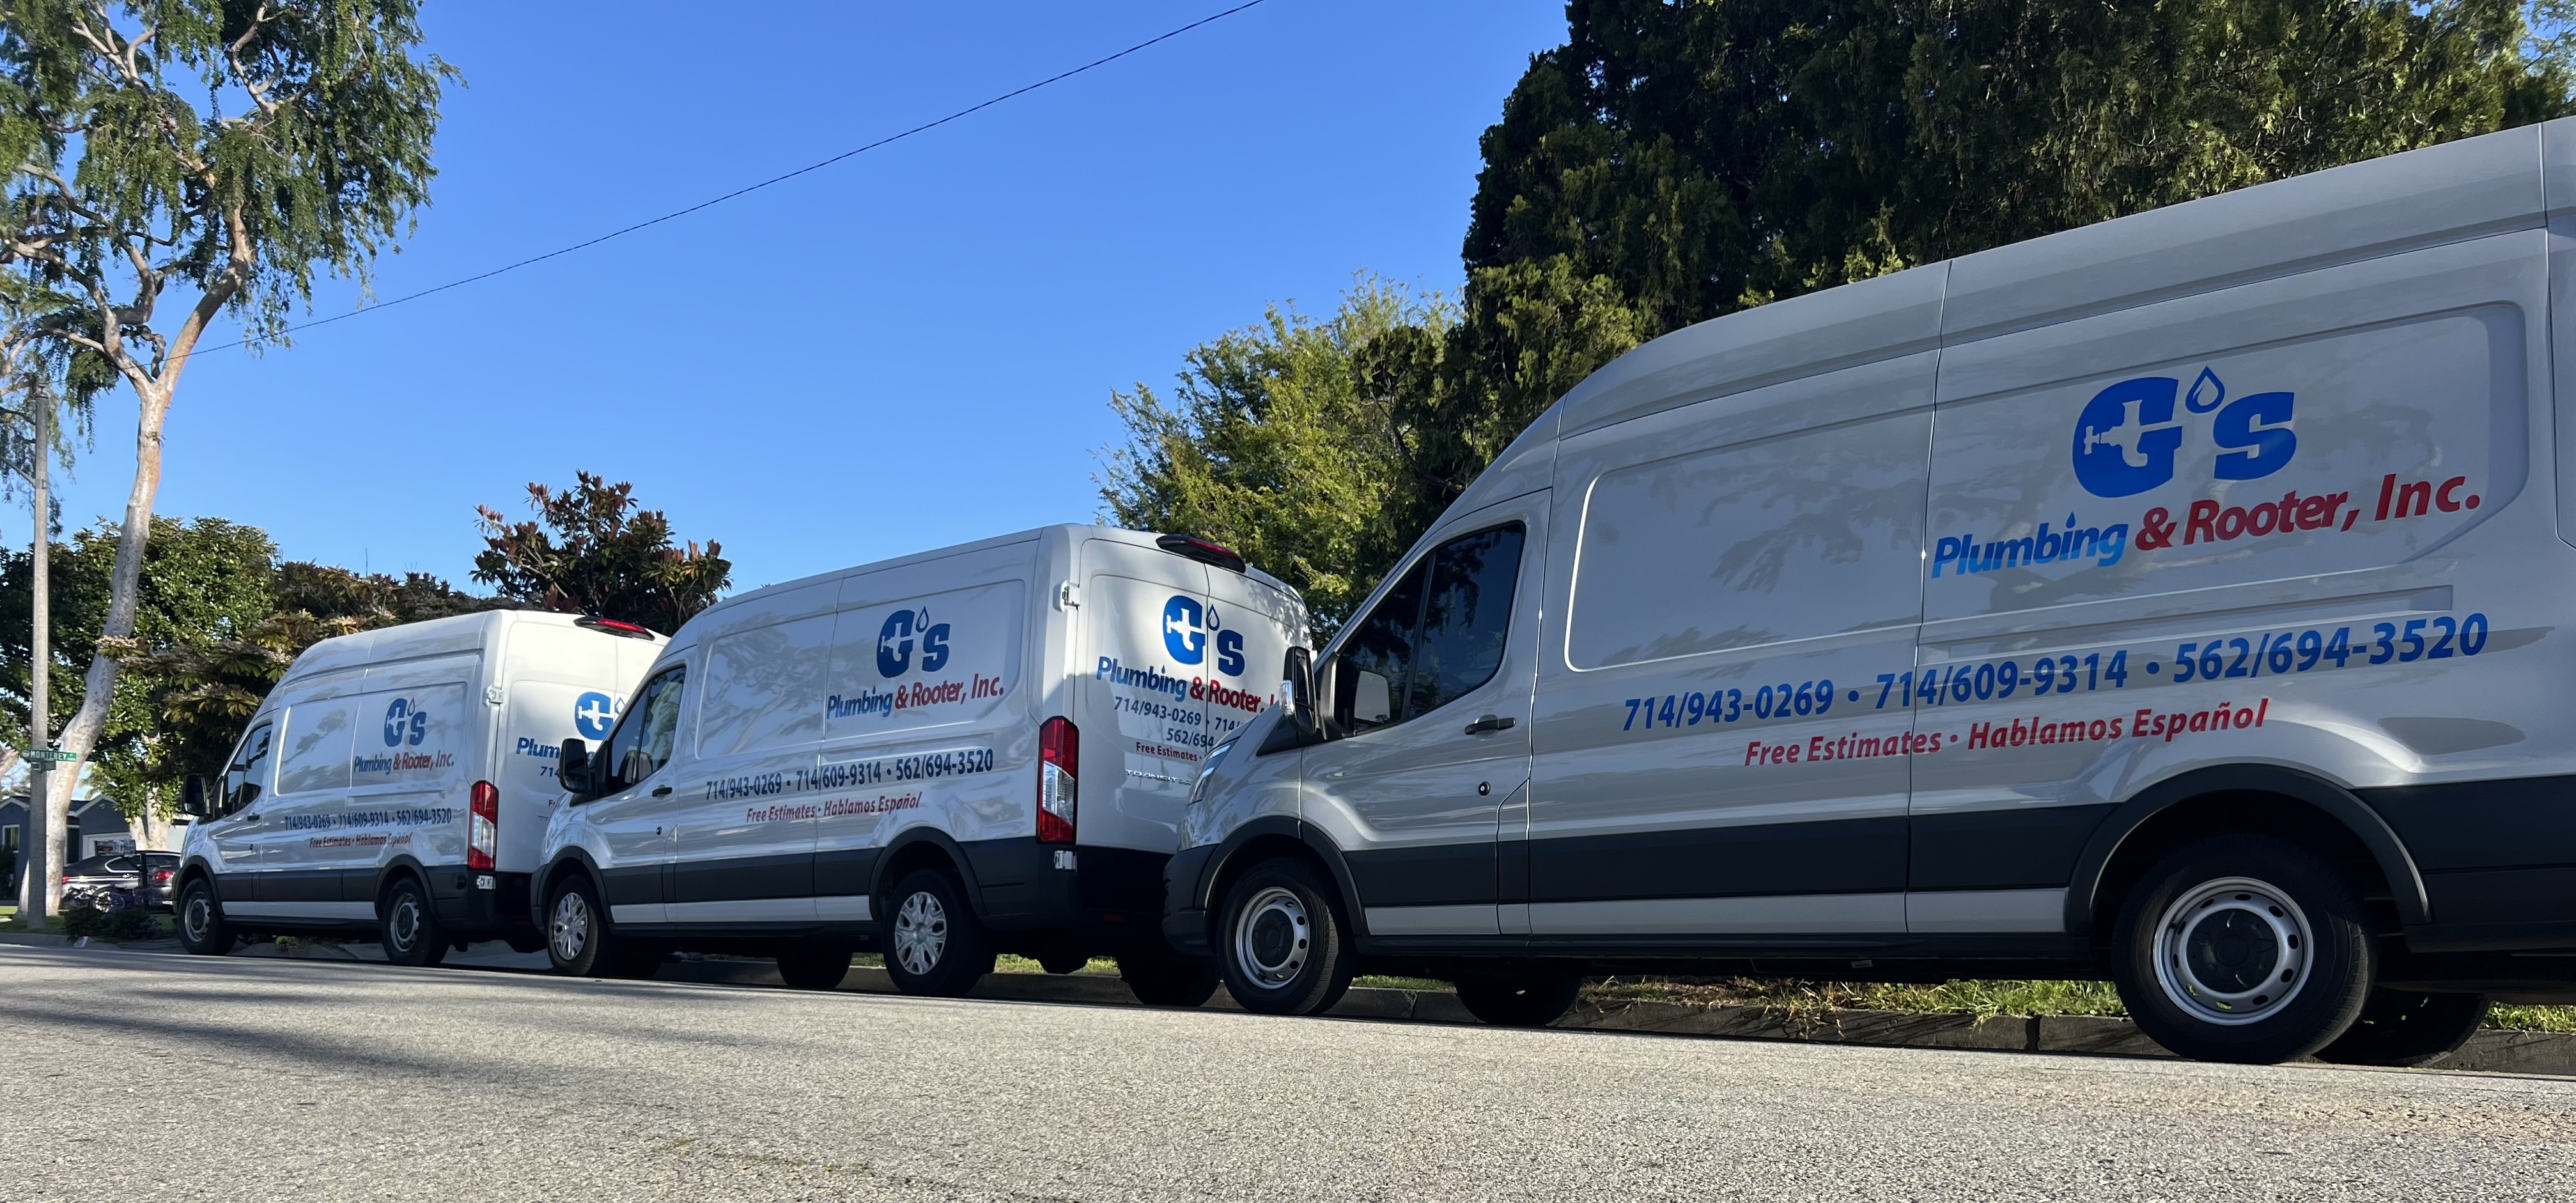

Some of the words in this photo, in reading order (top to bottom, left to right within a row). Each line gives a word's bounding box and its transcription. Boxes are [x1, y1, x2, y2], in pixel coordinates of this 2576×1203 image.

[1931, 511, 2129, 579] Plumbing
[2135, 507, 2178, 551] &
[2183, 490, 2361, 545] Rooter,
[2375, 473, 2481, 521] Inc.
[1096, 656, 1187, 702] Plumbing
[1190, 676, 1206, 701] &
[1623, 679, 1834, 731] 714/943-0269
[1875, 650, 2128, 709] 714/609-9314
[2173, 613, 2488, 682] 562/694-3520
[826, 685, 894, 719] Plumbing
[895, 685, 910, 710] &
[911, 680, 966, 708] Rooter,
[971, 673, 1004, 699] Inc.
[1114, 696, 1202, 726] 714/943-0269
[30, 750, 67, 760] MONTEREY
[1136, 741, 1155, 754] Free
[1158, 748, 1198, 762] Estimates
[1744, 741, 1800, 766] Free
[1806, 731, 1941, 763] Estimates
[1968, 712, 2122, 750] Hablamos
[2132, 698, 2269, 741] Español
[353, 752, 392, 775] Plumbing
[393, 752, 401, 770] &
[401, 752, 434, 771] Rooter,
[436, 749, 454, 768] Inc.
[706, 773, 782, 800] 714/943-0269
[796, 761, 881, 791] 714/609-9314
[896, 749, 994, 781] 562/694-3520
[747, 808, 767, 823] Free
[768, 803, 816, 821] Estimates
[824, 798, 875, 817] Hablamos
[878, 792, 922, 816] Español
